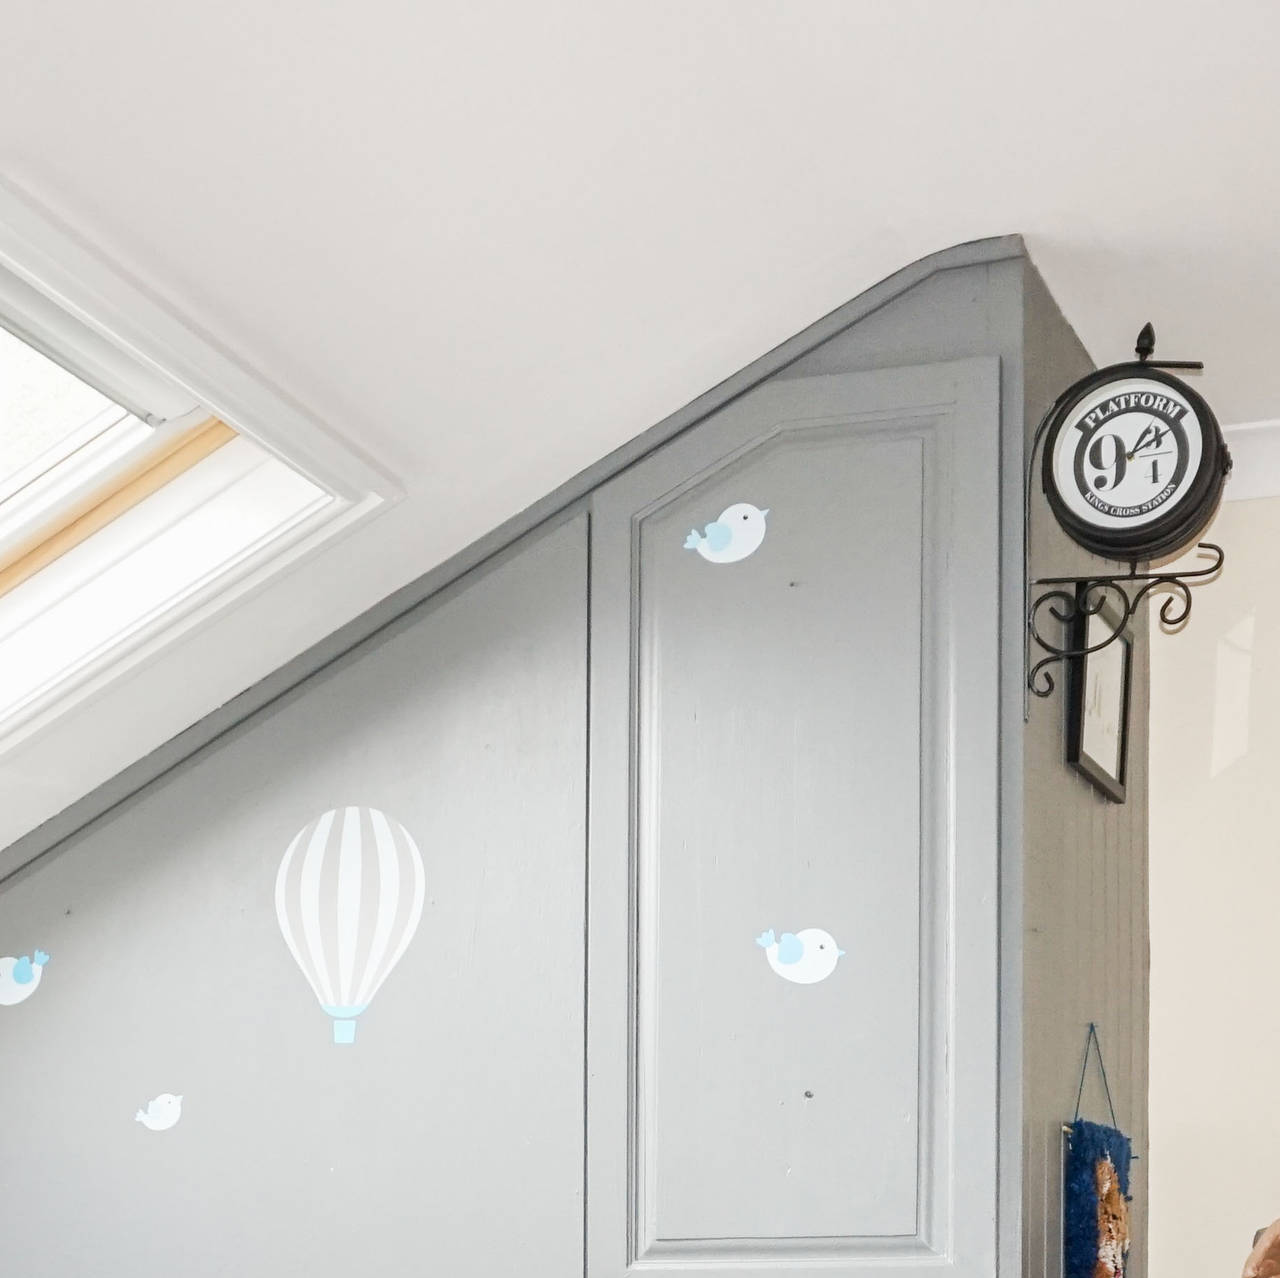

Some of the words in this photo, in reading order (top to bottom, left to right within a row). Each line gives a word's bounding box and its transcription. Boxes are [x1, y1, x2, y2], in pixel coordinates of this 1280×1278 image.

[1083, 393, 1181, 429] PLATFORM
[1084, 490, 1110, 513] KINGS
[1110, 506, 1141, 516] CROSS
[1142, 483, 1178, 513] STATION
